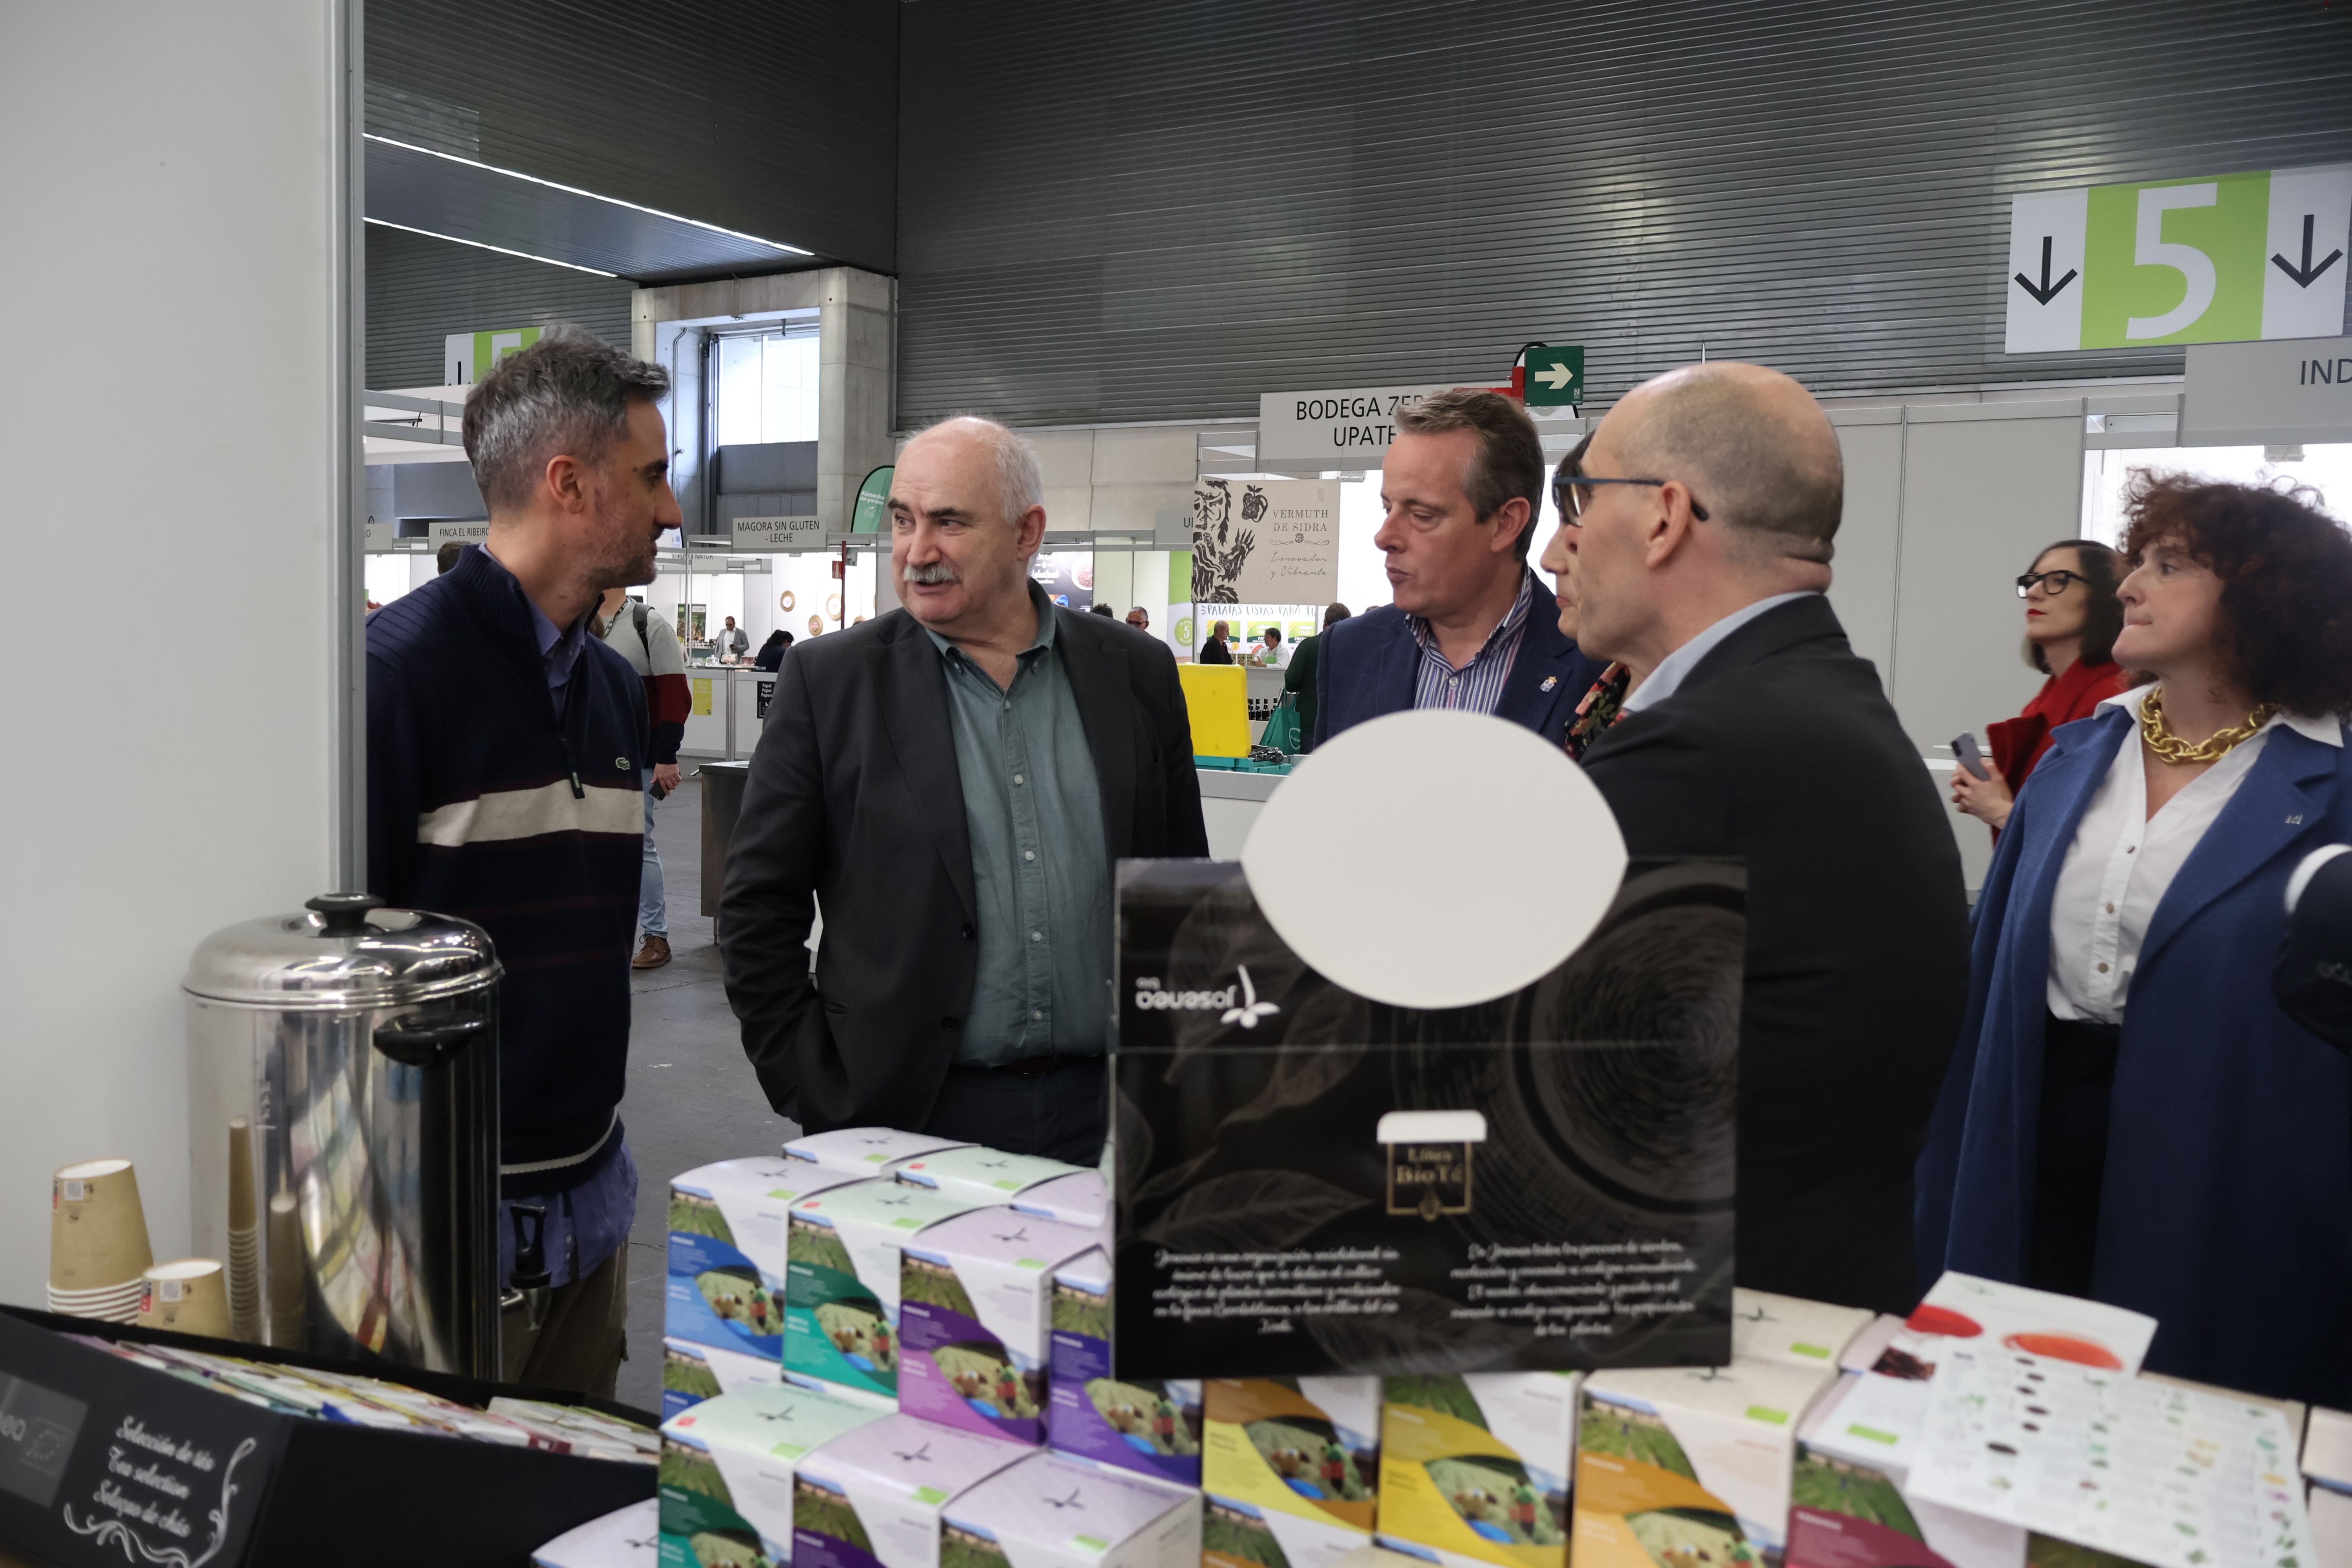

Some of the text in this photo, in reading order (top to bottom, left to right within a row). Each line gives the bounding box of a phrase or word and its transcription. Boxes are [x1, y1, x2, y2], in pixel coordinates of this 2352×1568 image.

[2125, 183, 2217, 339] 5
[2301, 358, 2352, 385] IND
[1297, 394, 1430, 420] BODEGA ZE
[1272, 510, 1328, 518] VERMUTH
[738, 521, 820, 531] MAGORA SIN GLUTEN
[1274, 523, 1327, 532] DE SIDRA
[439, 528, 457, 537] FINCA
[459, 528, 465, 536] EL
[770, 533, 793, 543] LECHE
[1281, 565, 1327, 577] Vibrante
[1279, 604, 1300, 617] PARA
[1183, 625, 1190, 639] 5
